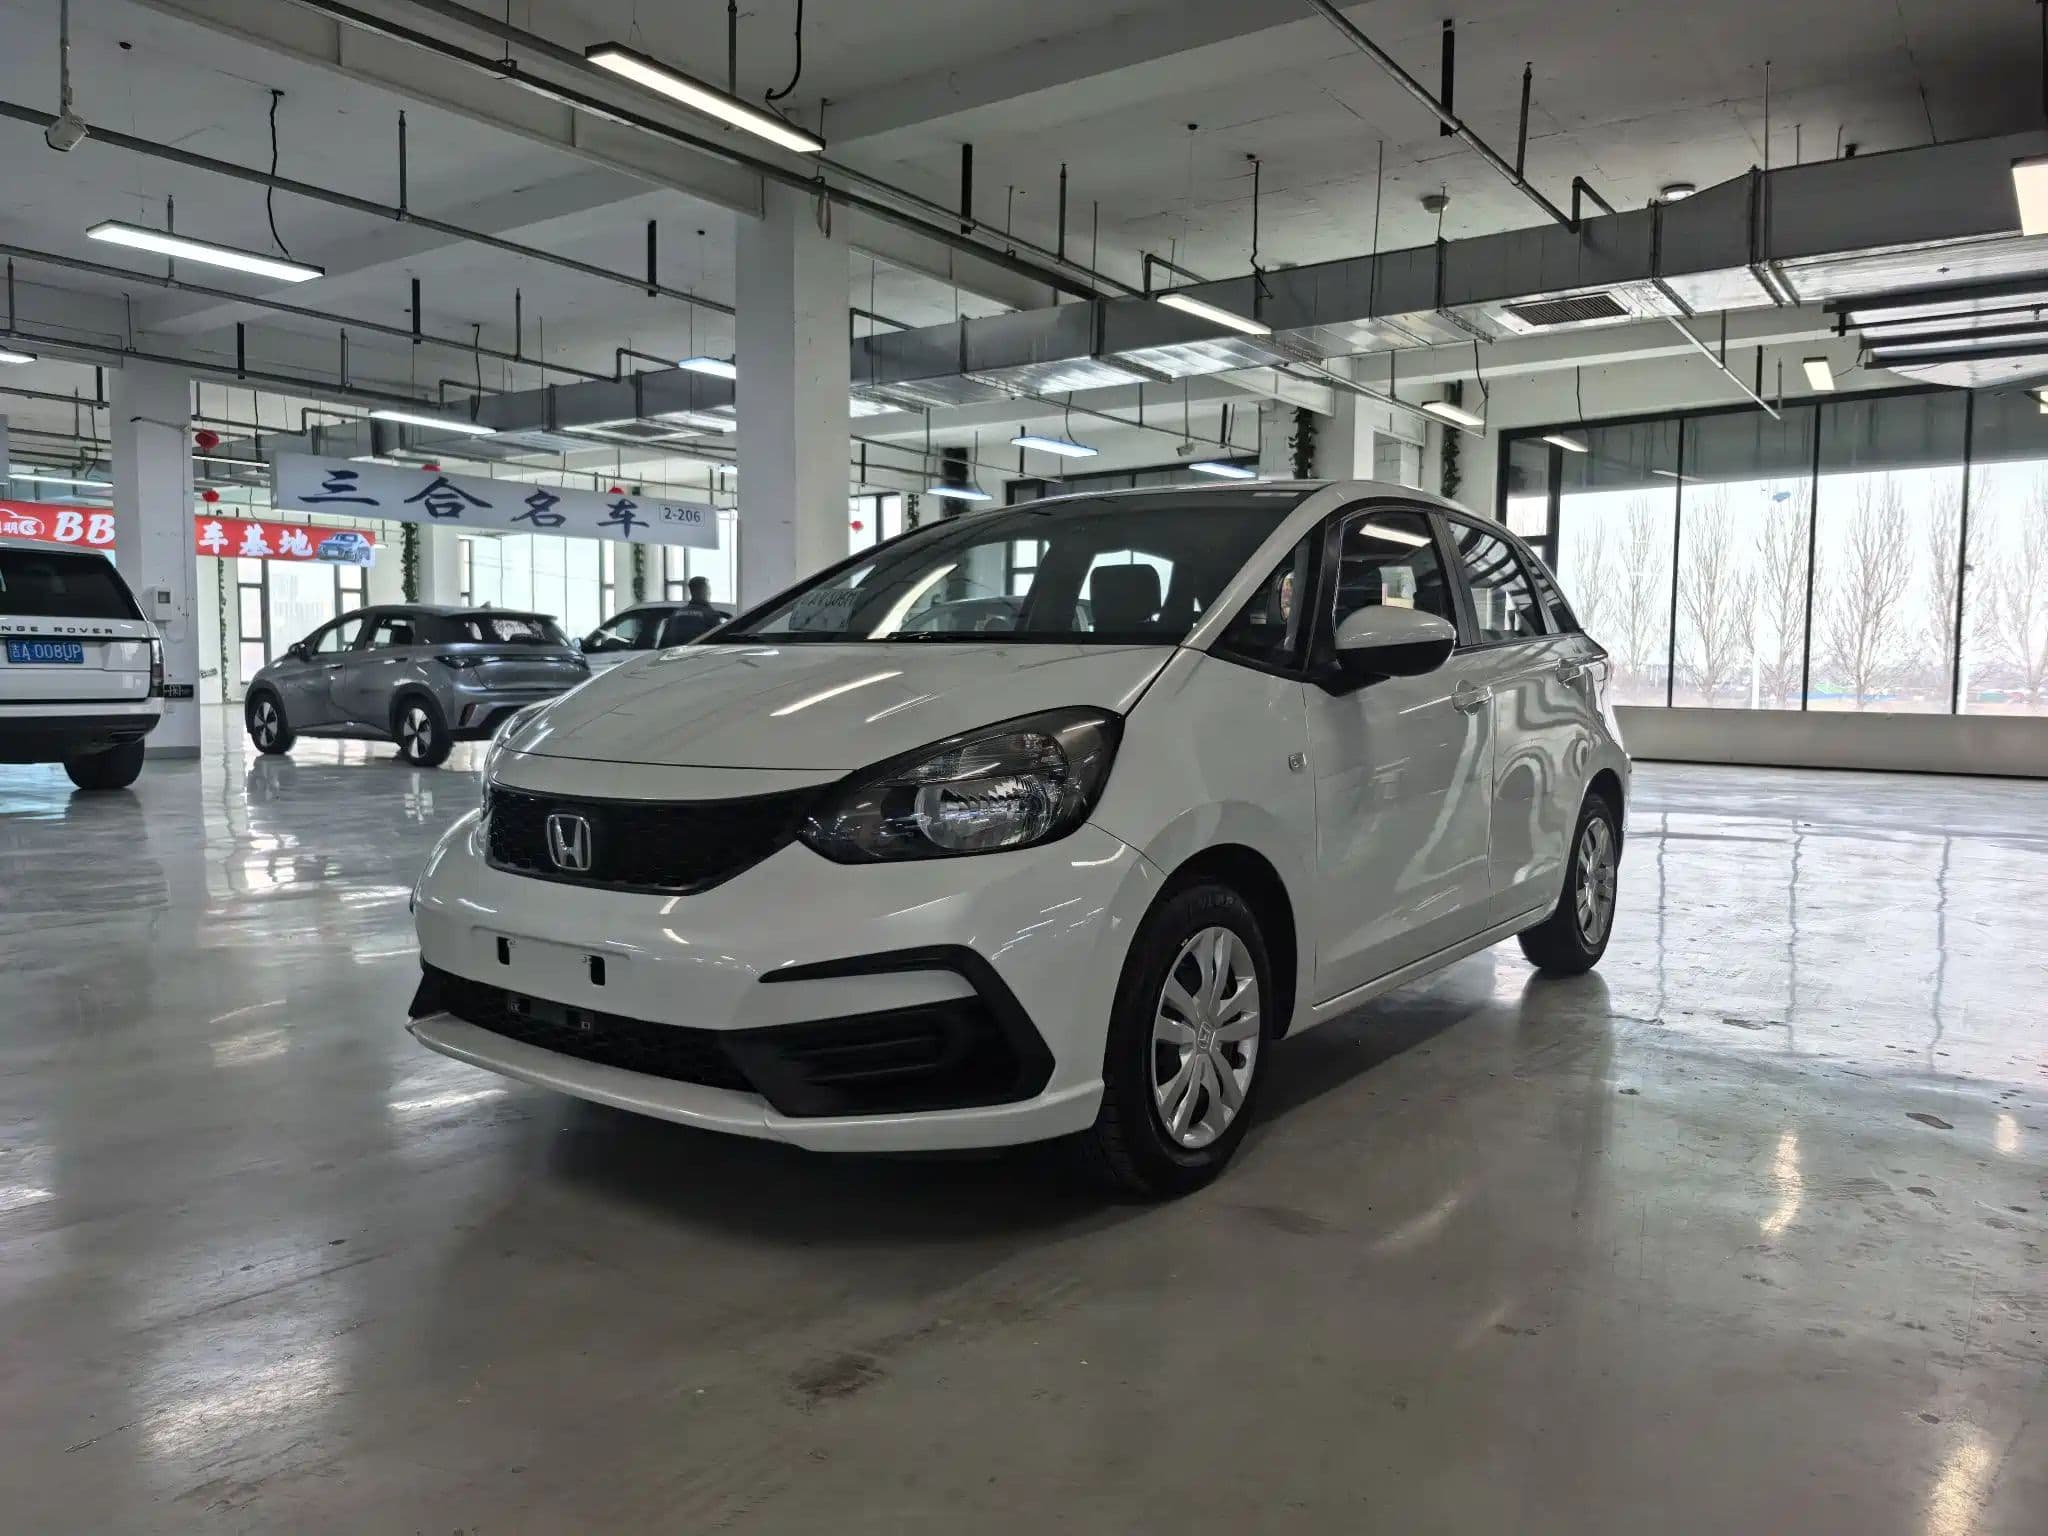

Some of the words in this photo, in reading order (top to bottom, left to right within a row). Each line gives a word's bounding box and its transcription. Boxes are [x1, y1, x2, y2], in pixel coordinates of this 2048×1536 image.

[298, 469, 650, 538] 三合名车
[664, 507, 701, 523] 2-206
[199, 520, 313, 556] 车基地
[0, 625, 39, 633] NGE
[54, 626, 113, 634] ROVER
